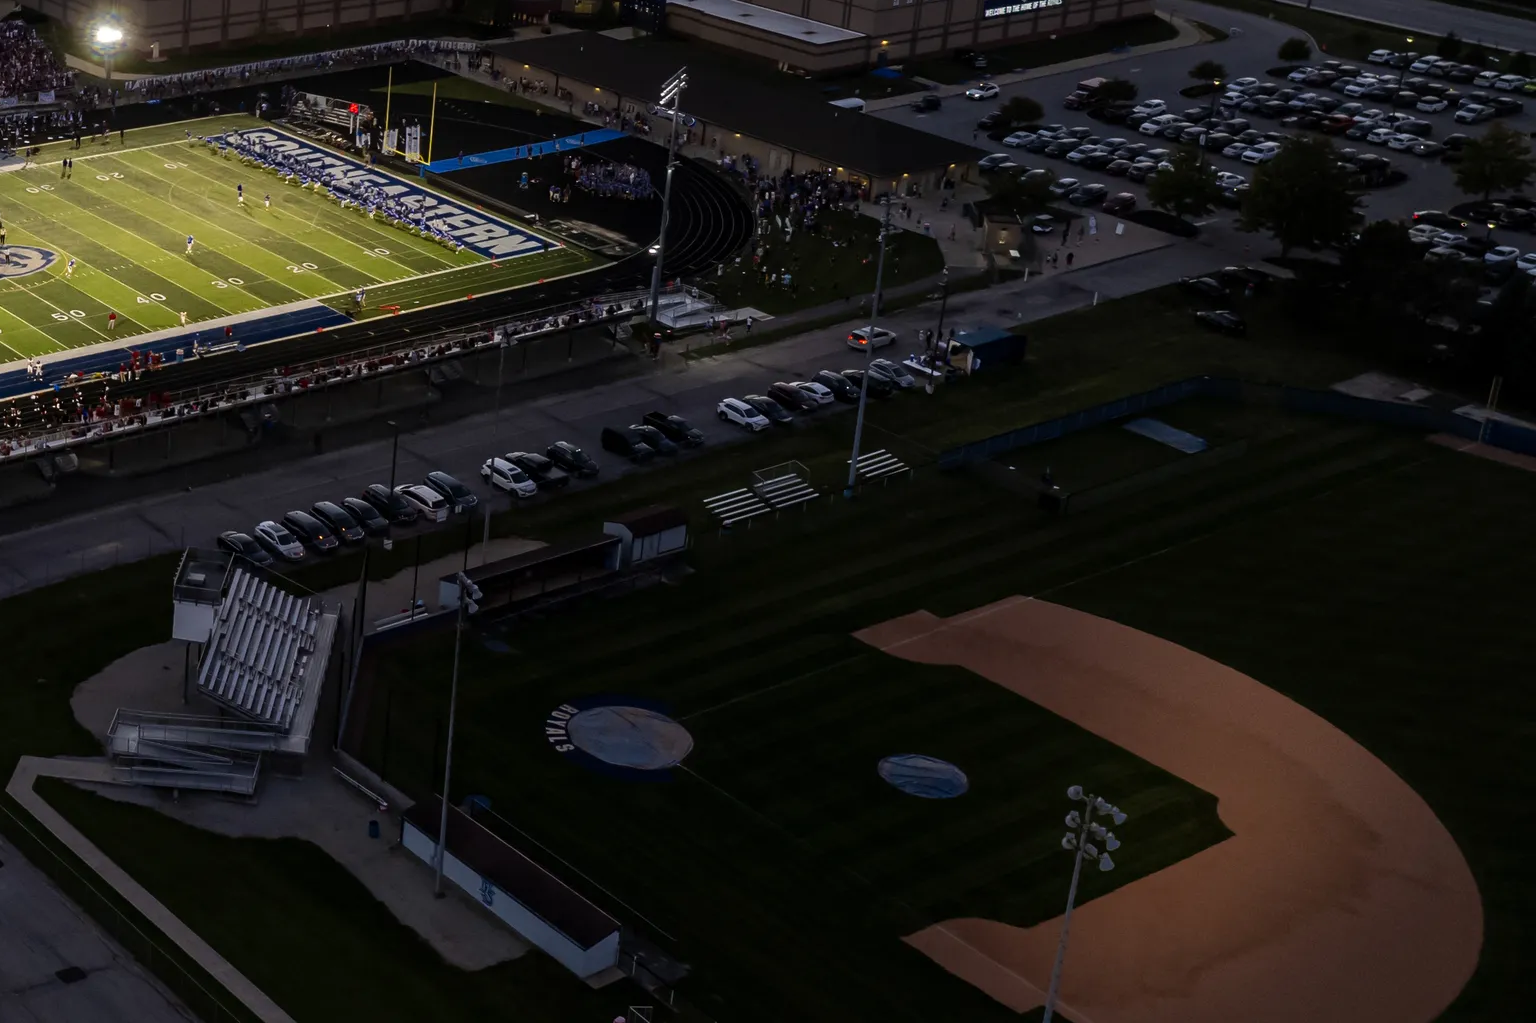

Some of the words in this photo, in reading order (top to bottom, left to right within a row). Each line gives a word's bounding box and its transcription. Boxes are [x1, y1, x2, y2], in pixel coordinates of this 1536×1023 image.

[985, 8, 1006, 17] WELCOME
[1012, 4, 1020, 13] THE
[1039, 0, 1047, 8] THE
[363, 247, 391, 258] 10
[286, 262, 319, 274] 20
[211, 277, 244, 289] 30
[136, 292, 167, 304] 40
[51, 309, 86, 321] 50
[545, 704, 580, 752] ROYALS
